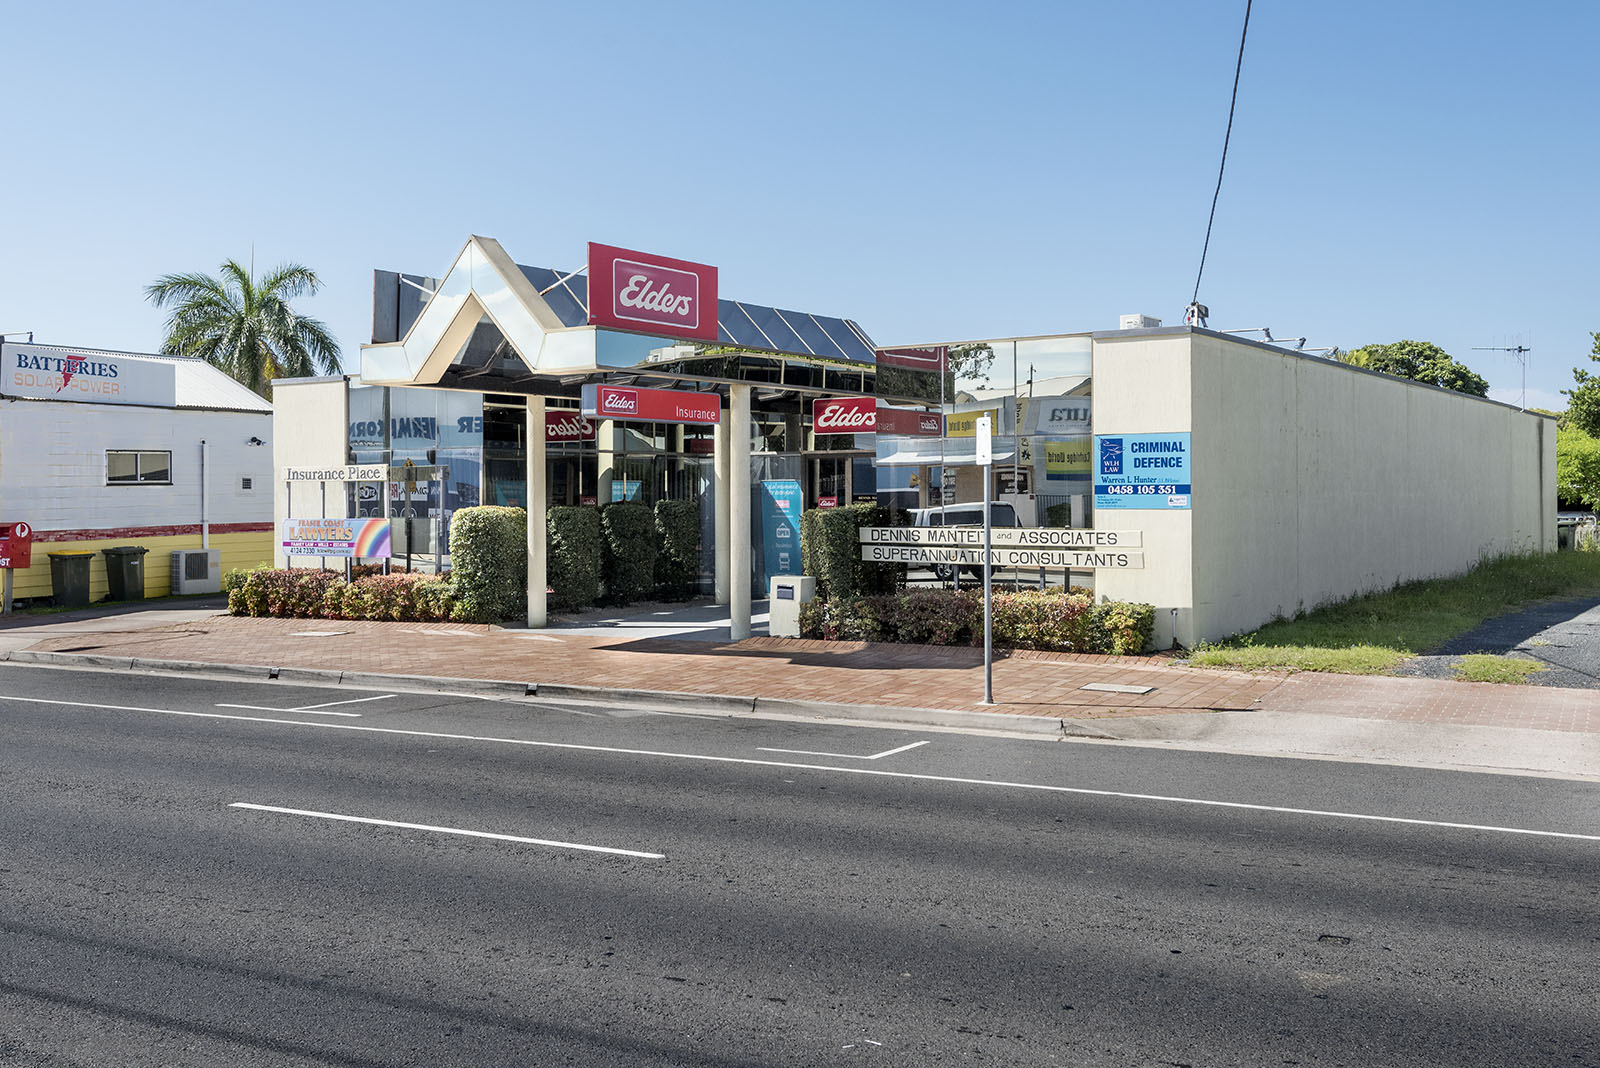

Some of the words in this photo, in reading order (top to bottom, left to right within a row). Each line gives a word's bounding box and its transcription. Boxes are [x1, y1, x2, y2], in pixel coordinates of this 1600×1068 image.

[619, 275, 693, 316] Elders
[16, 353, 118, 378] BATTERIES
[14, 372, 64, 389] SOLAR
[70, 378, 121, 395] POWER
[604, 393, 636, 410] Elders
[675, 405, 716, 420] Insurance
[817, 406, 876, 427] Elders
[1130, 441, 1186, 453] CRIMINAL
[1134, 457, 1182, 468] DEFENCE
[287, 466, 345, 481] Insurance
[347, 466, 381, 480] Place
[1107, 485, 1134, 494] 0458
[1137, 485, 1155, 494] 105
[1158, 485, 1176, 494] 351
[298, 519, 321, 527] FRASER
[323, 519, 344, 527] COAST
[289, 527, 353, 541] LAWYERS
[871, 529, 920, 542] DENNIS
[996, 532, 1012, 541] and
[1018, 531, 1118, 545] ASSOCIATES
[1008, 551, 1128, 567] CONSULTANTS
